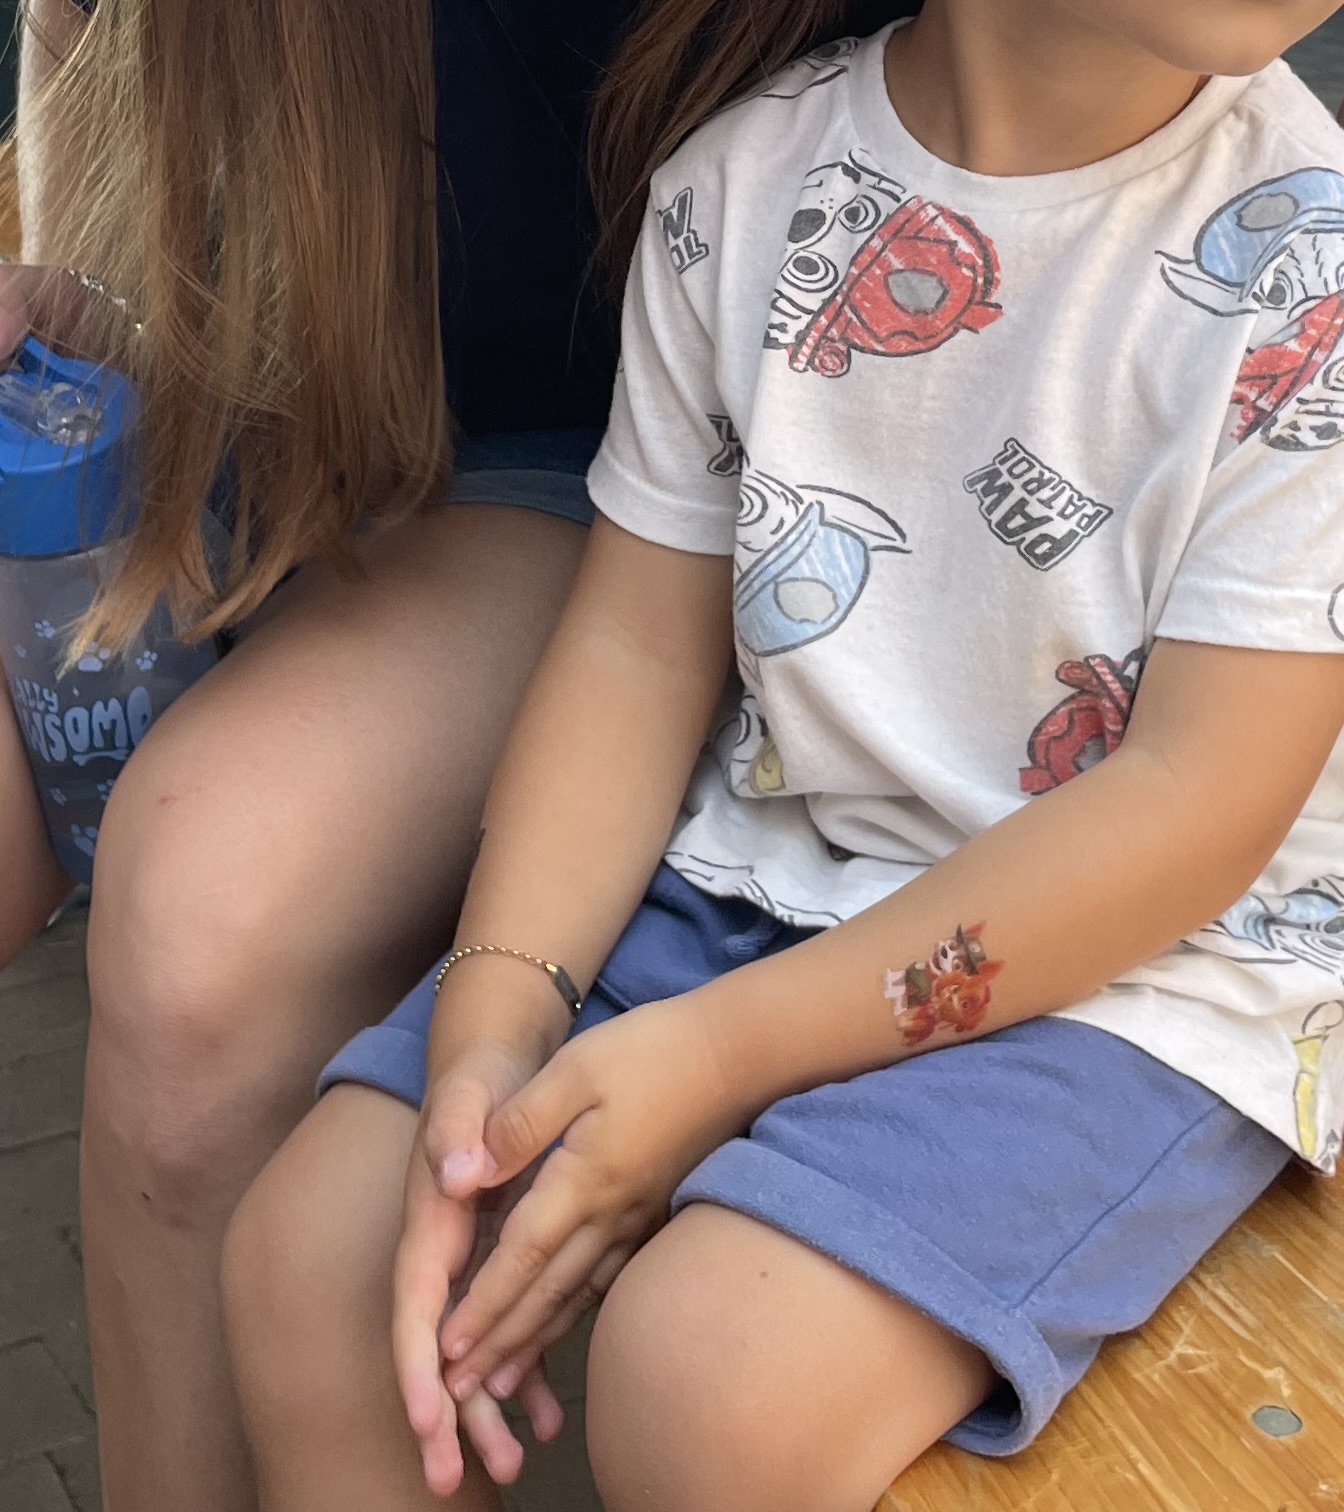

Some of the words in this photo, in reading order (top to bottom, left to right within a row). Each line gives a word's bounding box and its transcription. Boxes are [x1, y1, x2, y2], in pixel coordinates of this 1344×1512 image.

[966, 466, 1081, 567] PAW
[998, 442, 1104, 533] PATROL
[15, 675, 59, 714] ALLY
[19, 686, 153, 762] WSOME
